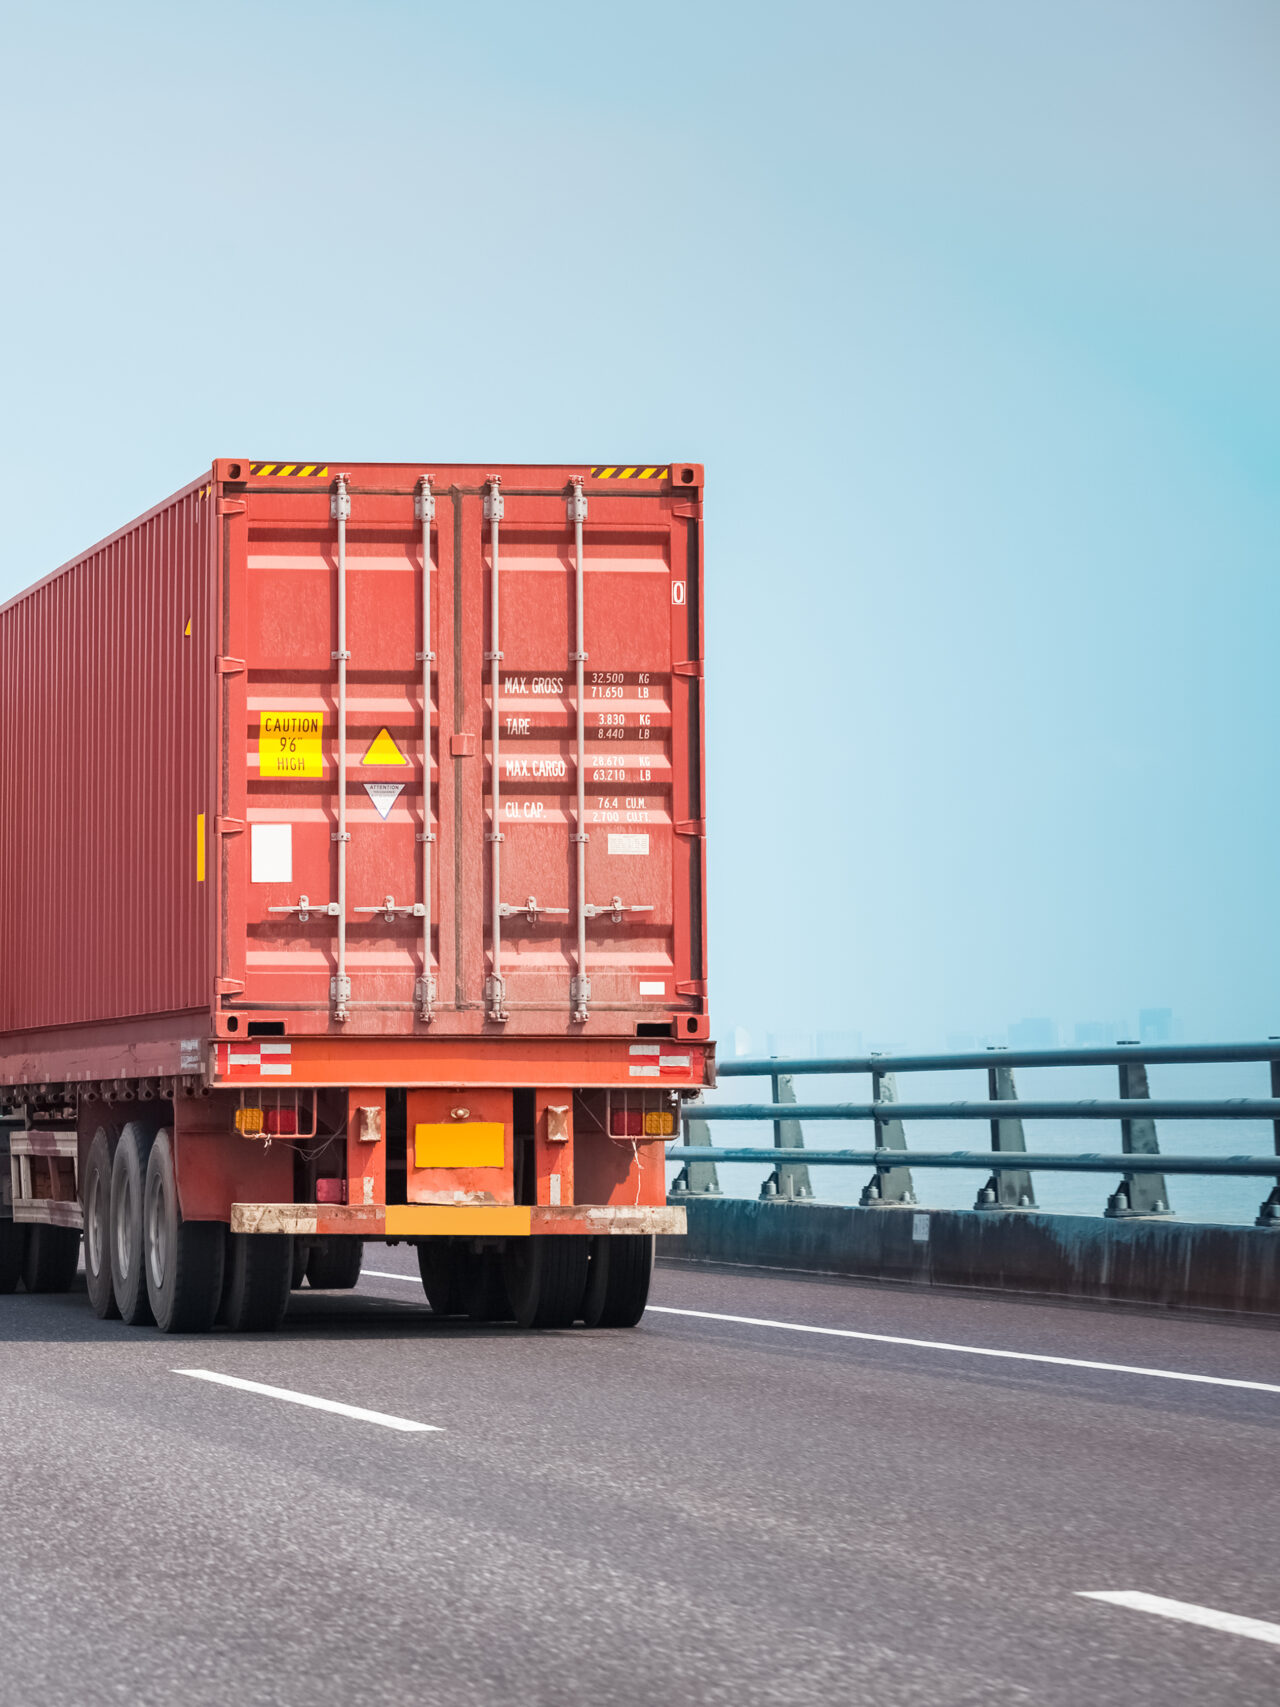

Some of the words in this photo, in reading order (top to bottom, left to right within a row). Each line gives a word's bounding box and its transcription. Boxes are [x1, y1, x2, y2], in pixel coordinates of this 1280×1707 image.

[591, 673, 624, 683] 32.500
[638, 673, 650, 684] KG
[504, 677, 529, 694] MAX.
[532, 677, 564, 694] GROSS
[591, 686, 624, 698] 71.650
[638, 687, 649, 698] LB
[265, 718, 318, 732] CAUTION
[599, 713, 625, 725] 3.830
[639, 714, 651, 725] KG
[506, 718, 531, 735] TARE
[598, 728, 625, 739] 8.440
[638, 729, 650, 740] LB
[277, 757, 305, 771] HIGH
[592, 755, 625, 767] 28.670
[639, 756, 651, 767] KG
[506, 760, 531, 777] MAX.
[532, 760, 566, 777] CARGO
[593, 769, 626, 781] 63.210
[640, 769, 652, 781] LB
[597, 797, 618, 809] 76.4
[505, 801, 522, 818] CU.
[523, 801, 547, 818] CAP.
[592, 811, 620, 822] 2.700
